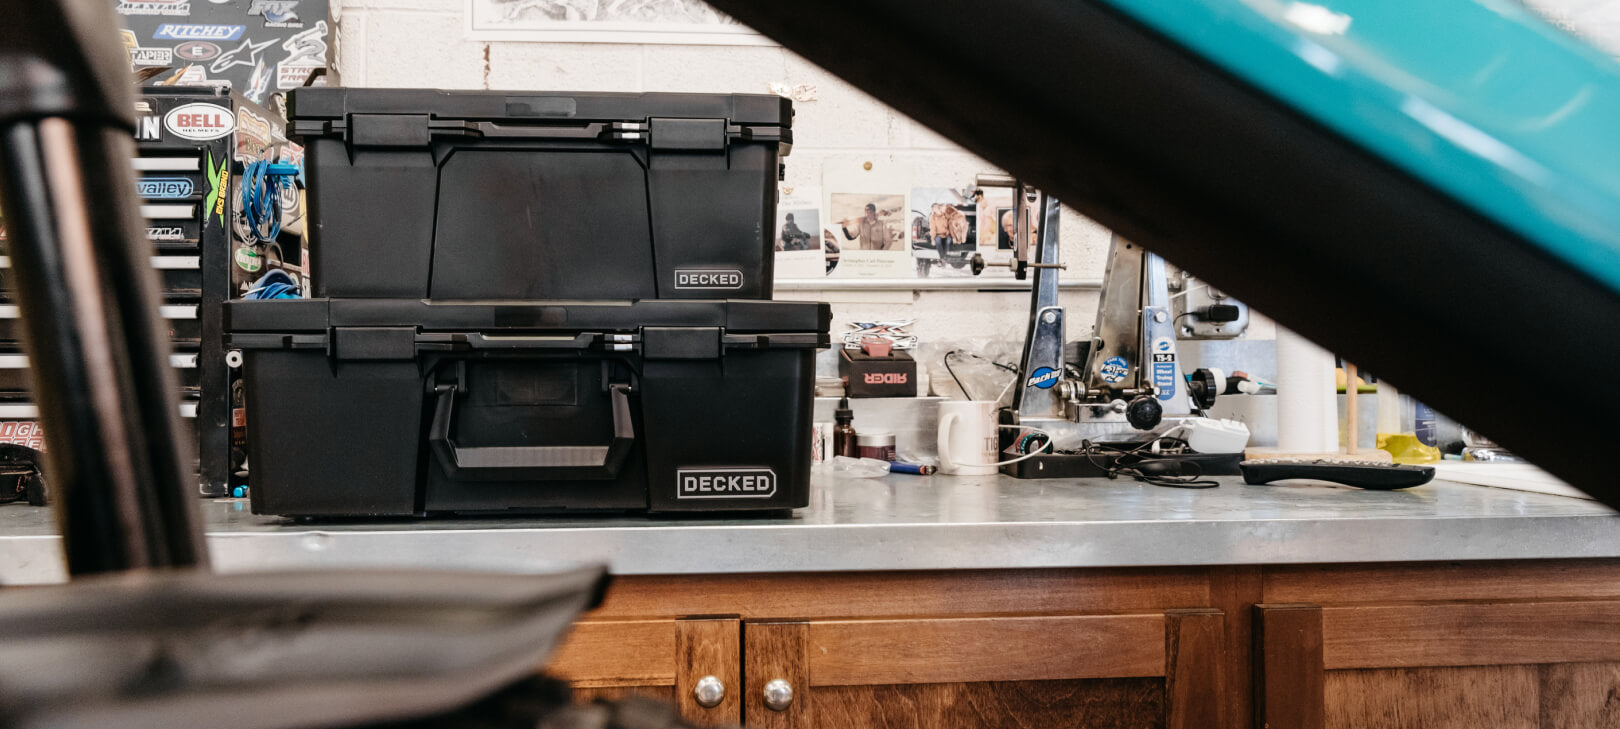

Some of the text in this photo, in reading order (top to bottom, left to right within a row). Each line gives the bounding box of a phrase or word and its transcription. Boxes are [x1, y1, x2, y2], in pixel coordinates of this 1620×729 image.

[159, 24, 240, 38] RITCHEY
[191, 46, 203, 56] E
[176, 114, 225, 128] BELL
[679, 274, 739, 285] DECKED
[1155, 354, 1173, 362] TS-2
[684, 475, 770, 492] DECKED
